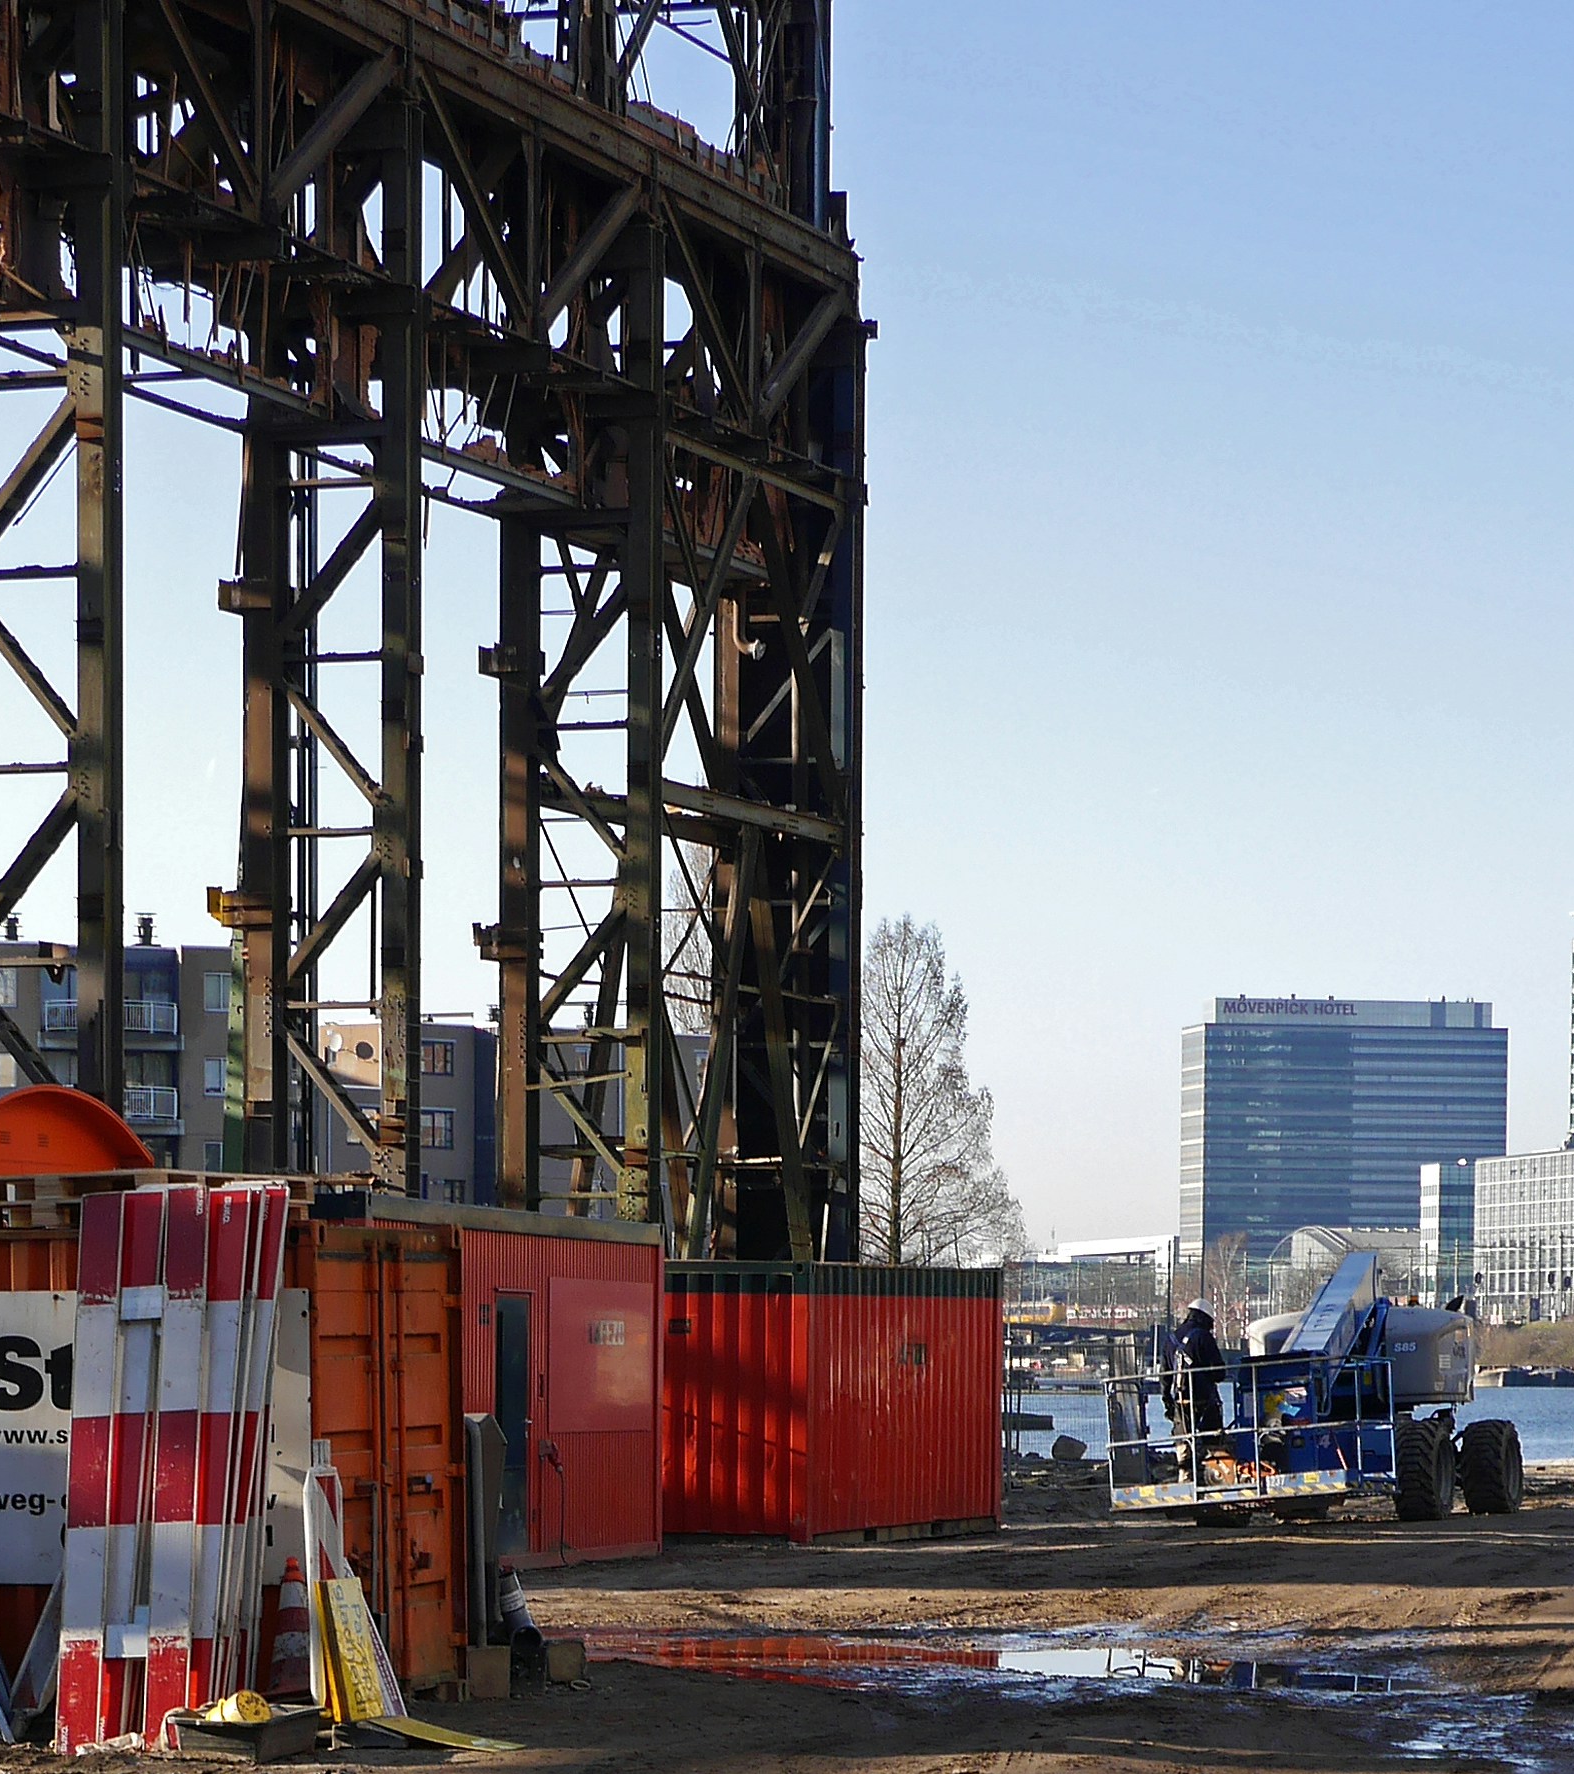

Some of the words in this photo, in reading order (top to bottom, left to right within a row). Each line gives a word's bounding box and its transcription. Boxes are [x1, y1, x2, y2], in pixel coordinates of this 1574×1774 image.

[1224, 1000, 1309, 1015] MÖVENPICK
[1313, 1002, 1357, 1016] HOTEL
[1394, 1342, 1416, 1352] S85
